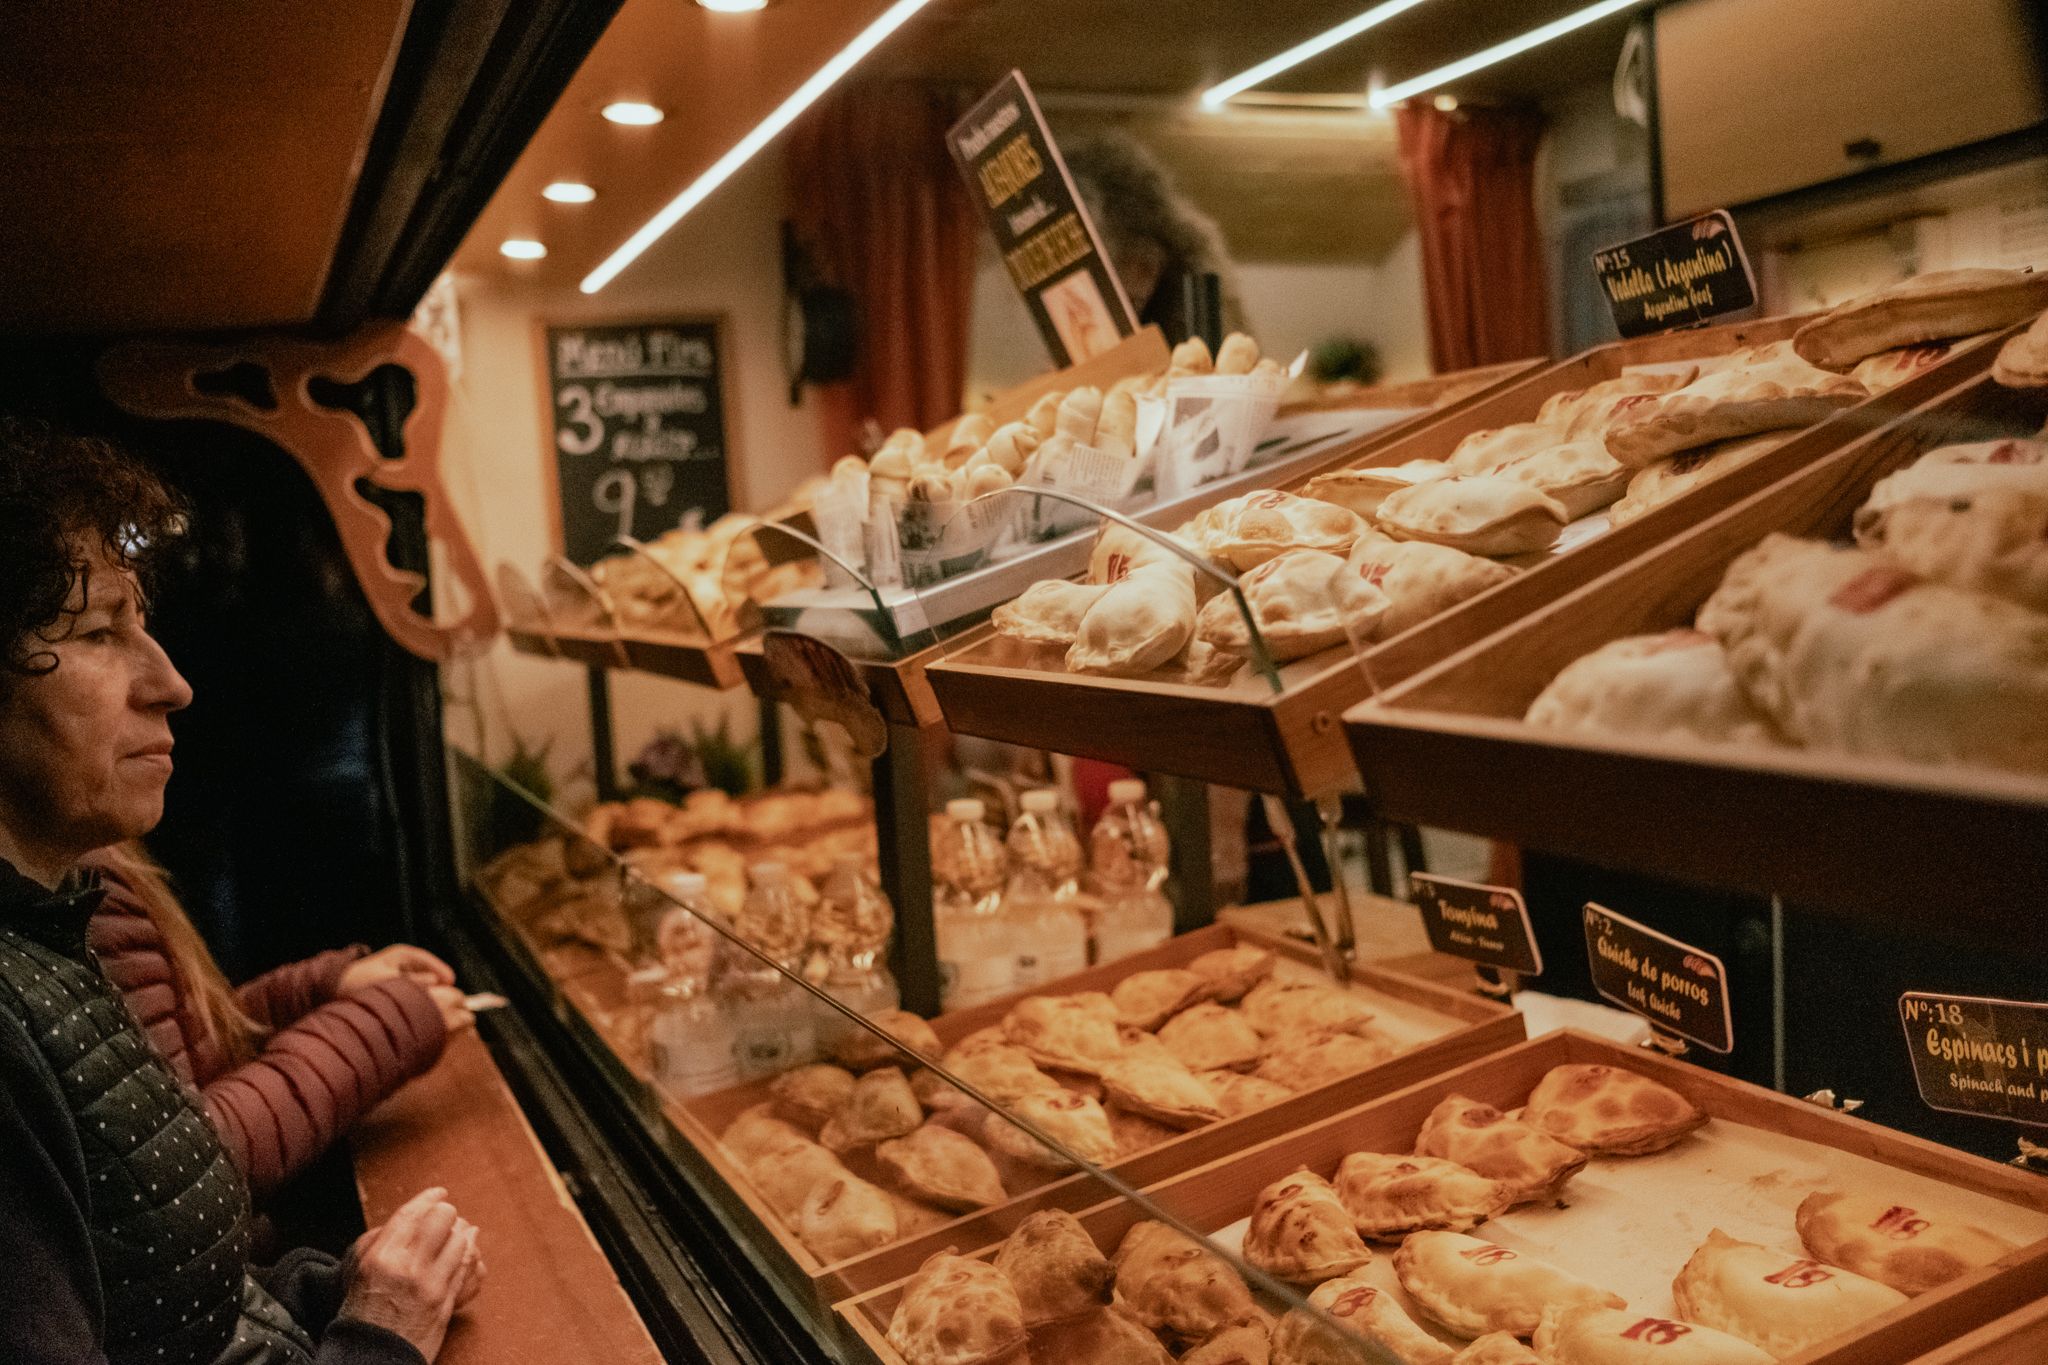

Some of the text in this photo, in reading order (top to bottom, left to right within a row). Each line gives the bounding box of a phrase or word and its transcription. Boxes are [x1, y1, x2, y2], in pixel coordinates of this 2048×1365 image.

[557, 383, 605, 456] 3
[1597, 935, 1709, 1007] Quiche de porros
[1926, 1027, 2018, 1069] Espinacs
[2021, 1037, 2030, 1068] i
[1948, 1072, 2004, 1094] Spinach
[2007, 1082, 2036, 1099] and
